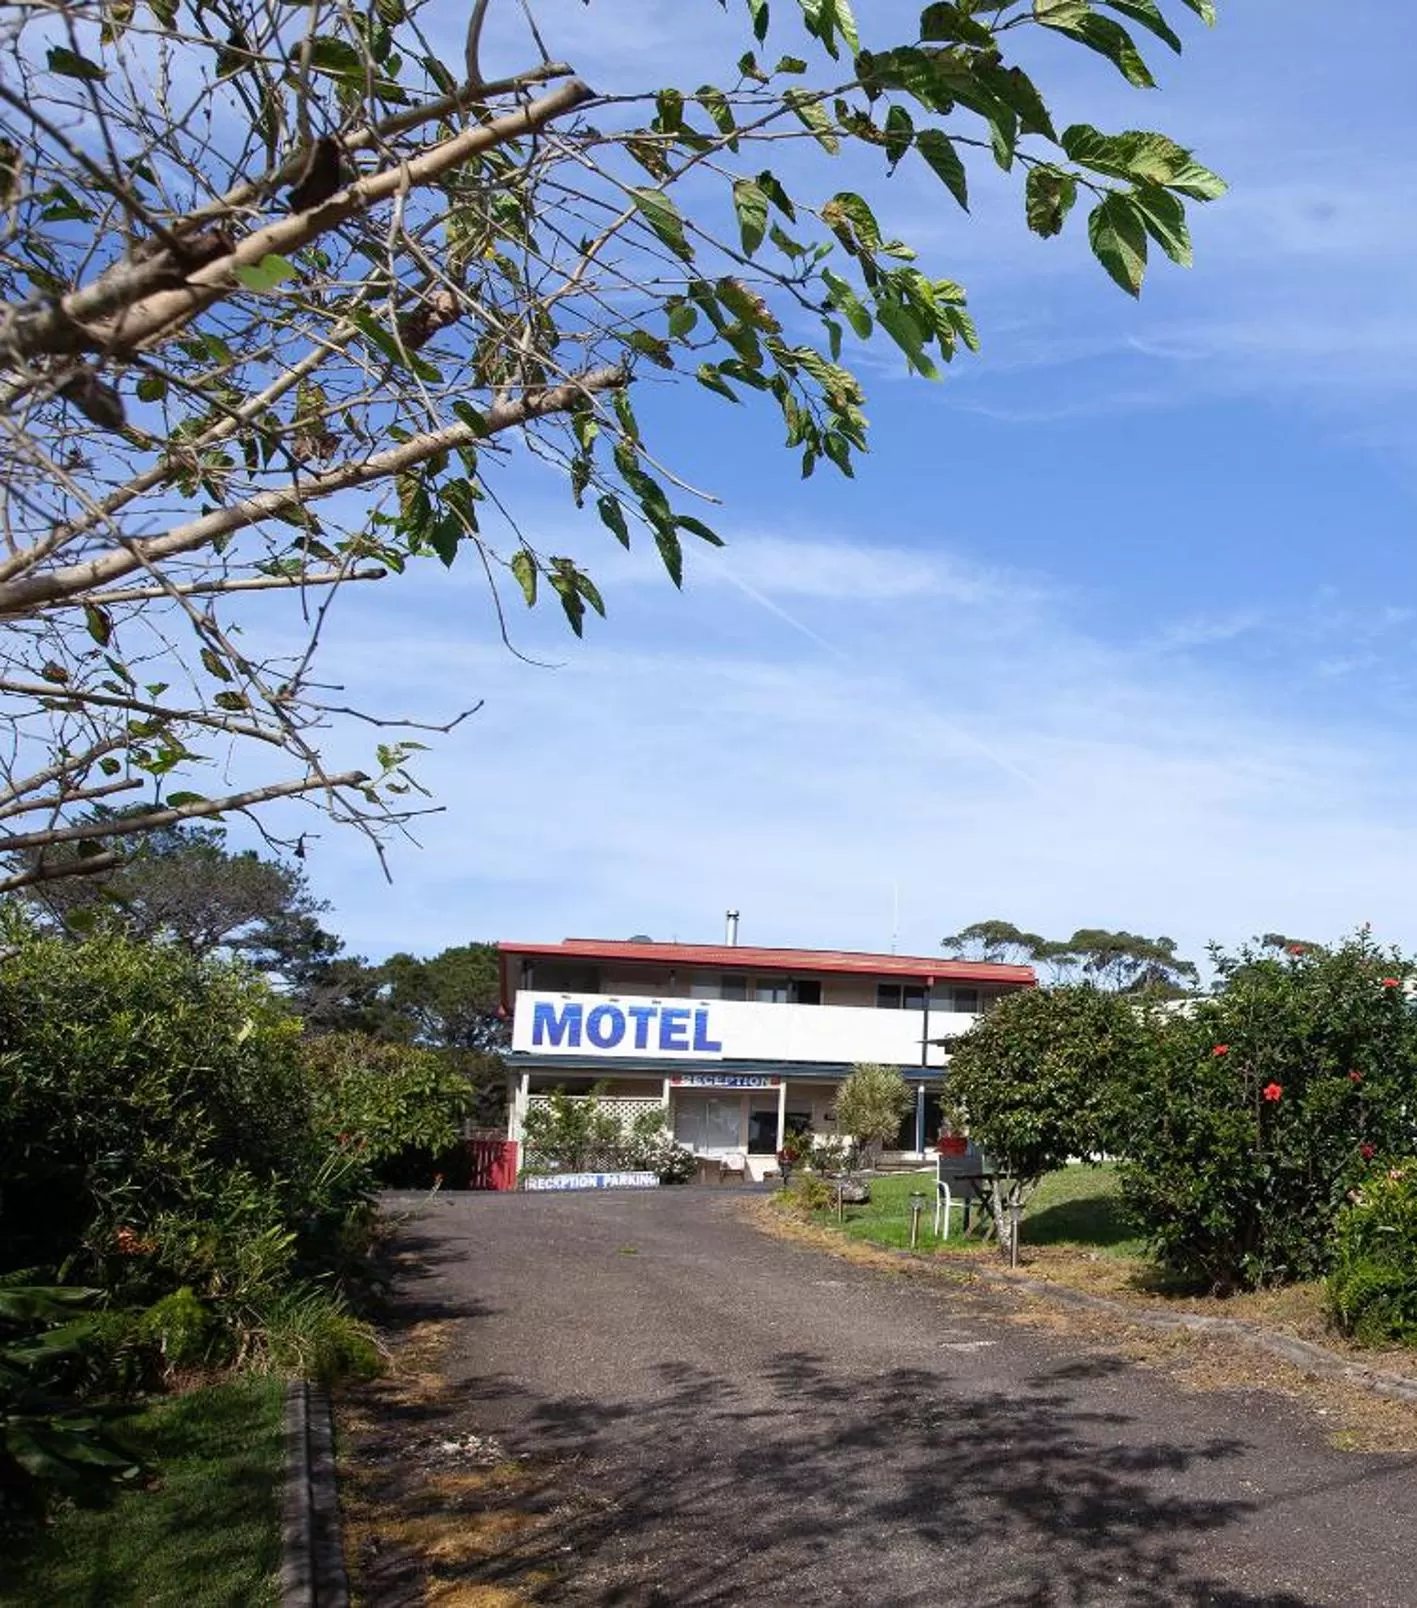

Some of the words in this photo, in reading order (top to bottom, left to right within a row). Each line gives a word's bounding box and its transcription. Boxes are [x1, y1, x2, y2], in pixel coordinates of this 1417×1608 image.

[532, 1001, 722, 1053] MOTEL
[681, 1073, 770, 1088] RECEPTION
[529, 1175, 598, 1190] RECEPTION
[602, 1174, 658, 1188] PARKING
